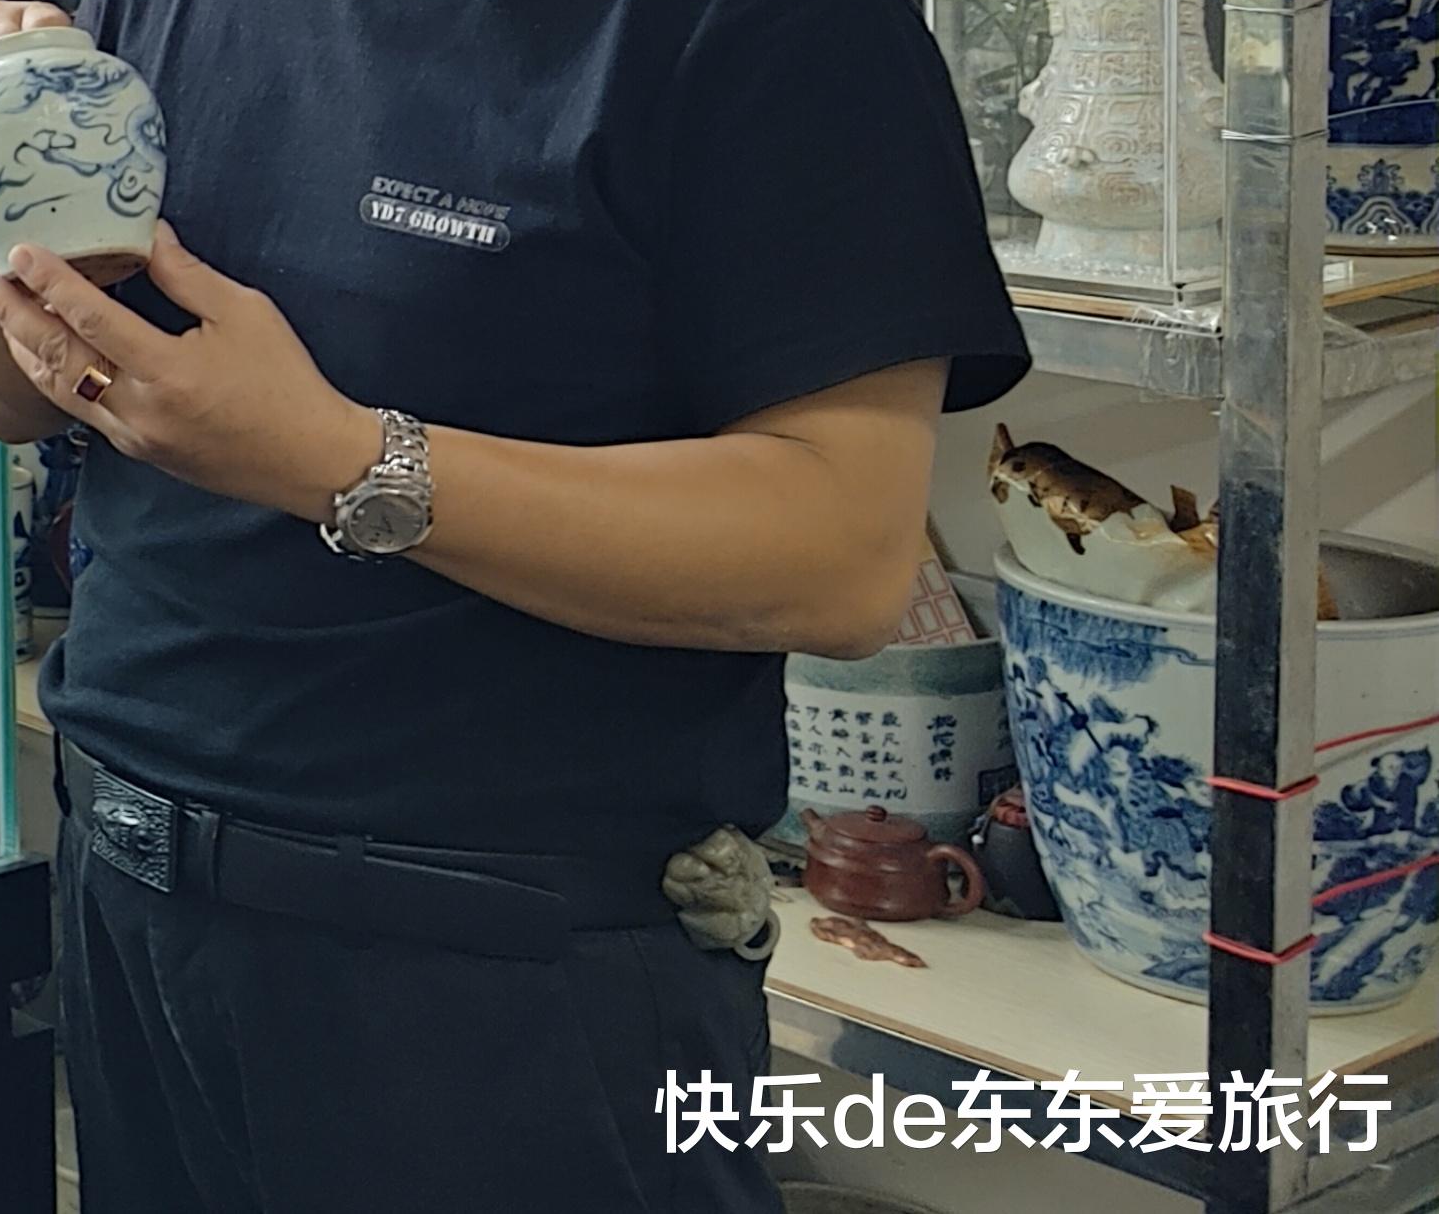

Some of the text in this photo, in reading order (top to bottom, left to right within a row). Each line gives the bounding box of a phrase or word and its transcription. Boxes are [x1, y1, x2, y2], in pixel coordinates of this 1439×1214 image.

[371, 176, 440, 204] EXPECT
[438, 193, 452, 209] A
[409, 209, 498, 244] GROWTH
